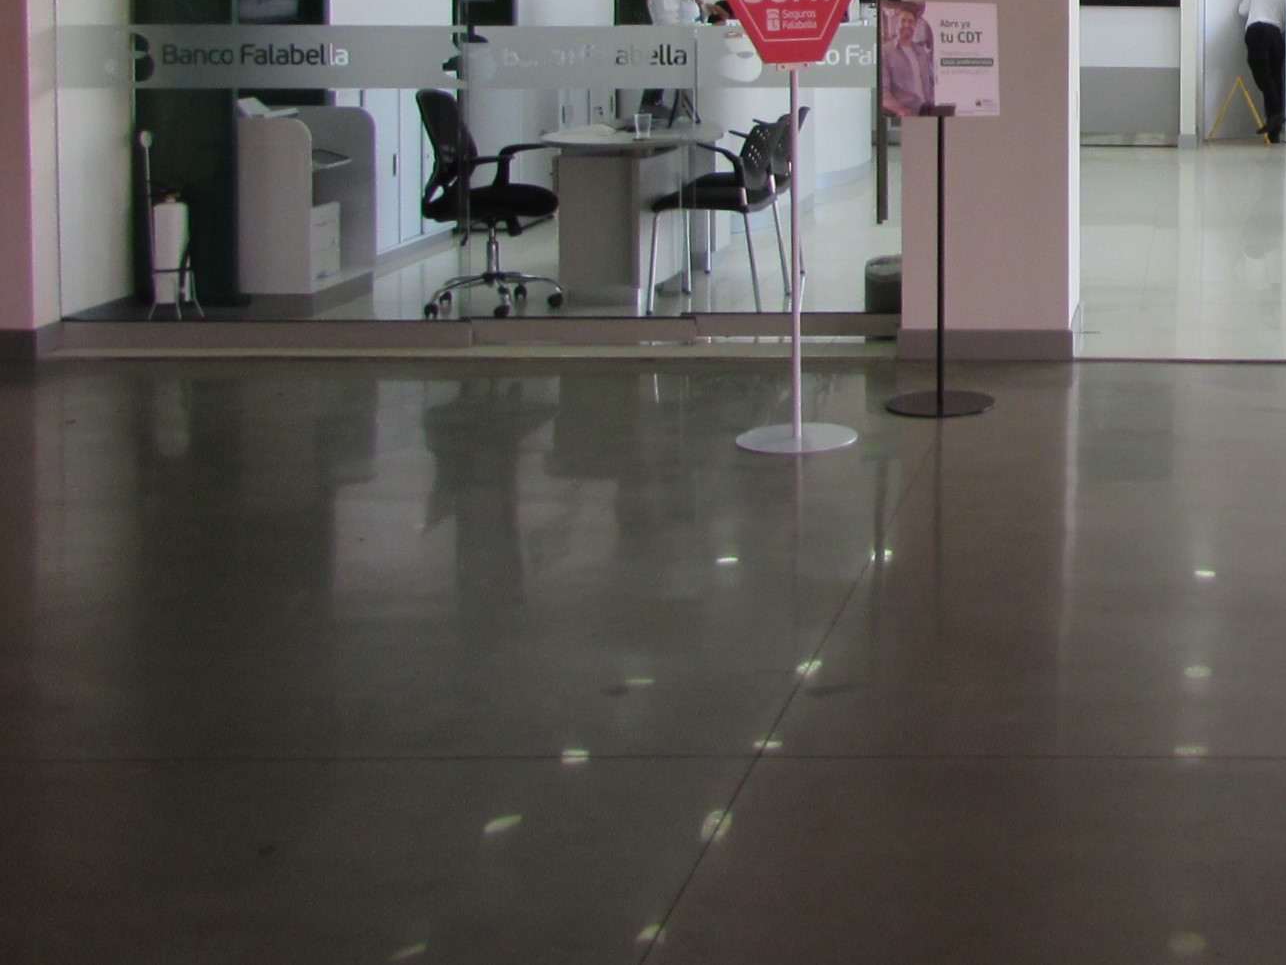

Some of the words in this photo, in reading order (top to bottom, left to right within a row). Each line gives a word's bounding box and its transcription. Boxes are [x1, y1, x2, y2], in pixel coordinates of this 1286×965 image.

[782, 9, 817, 20] Seguros
[782, 20, 818, 30] Falabella
[940, 19, 959, 28] Abre
[961, 21, 971, 30] ya
[941, 31, 954, 43] tu
[958, 31, 983, 44] CDT
[161, 44, 233, 65] Banco
[240, 43, 349, 66] Falabella
